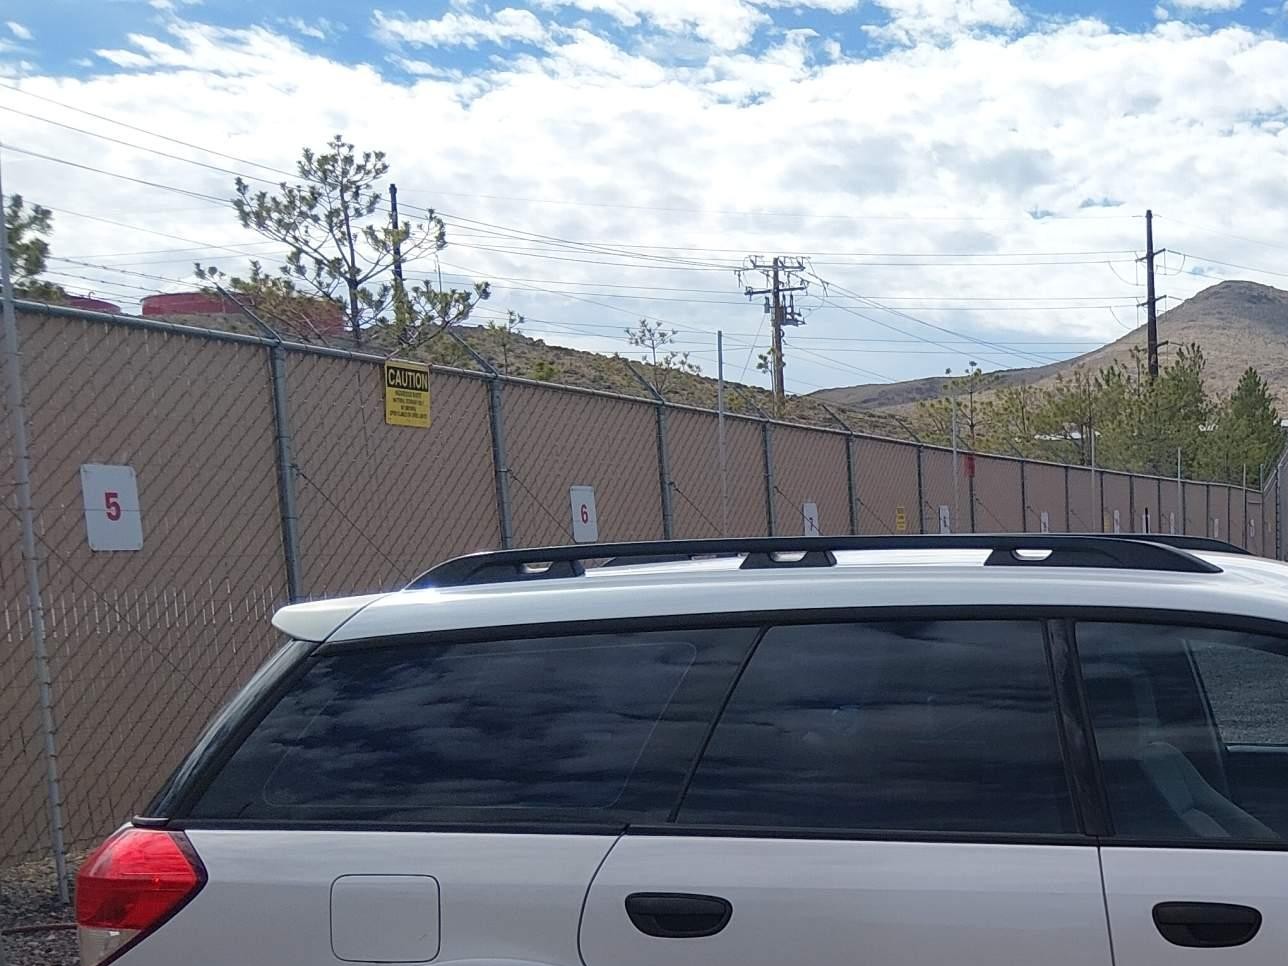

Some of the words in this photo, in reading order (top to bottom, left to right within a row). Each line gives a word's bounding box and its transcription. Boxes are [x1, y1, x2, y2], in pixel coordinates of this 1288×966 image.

[388, 368, 428, 390] CAUTION
[104, 492, 122, 521] 5
[580, 503, 589, 524] 6
